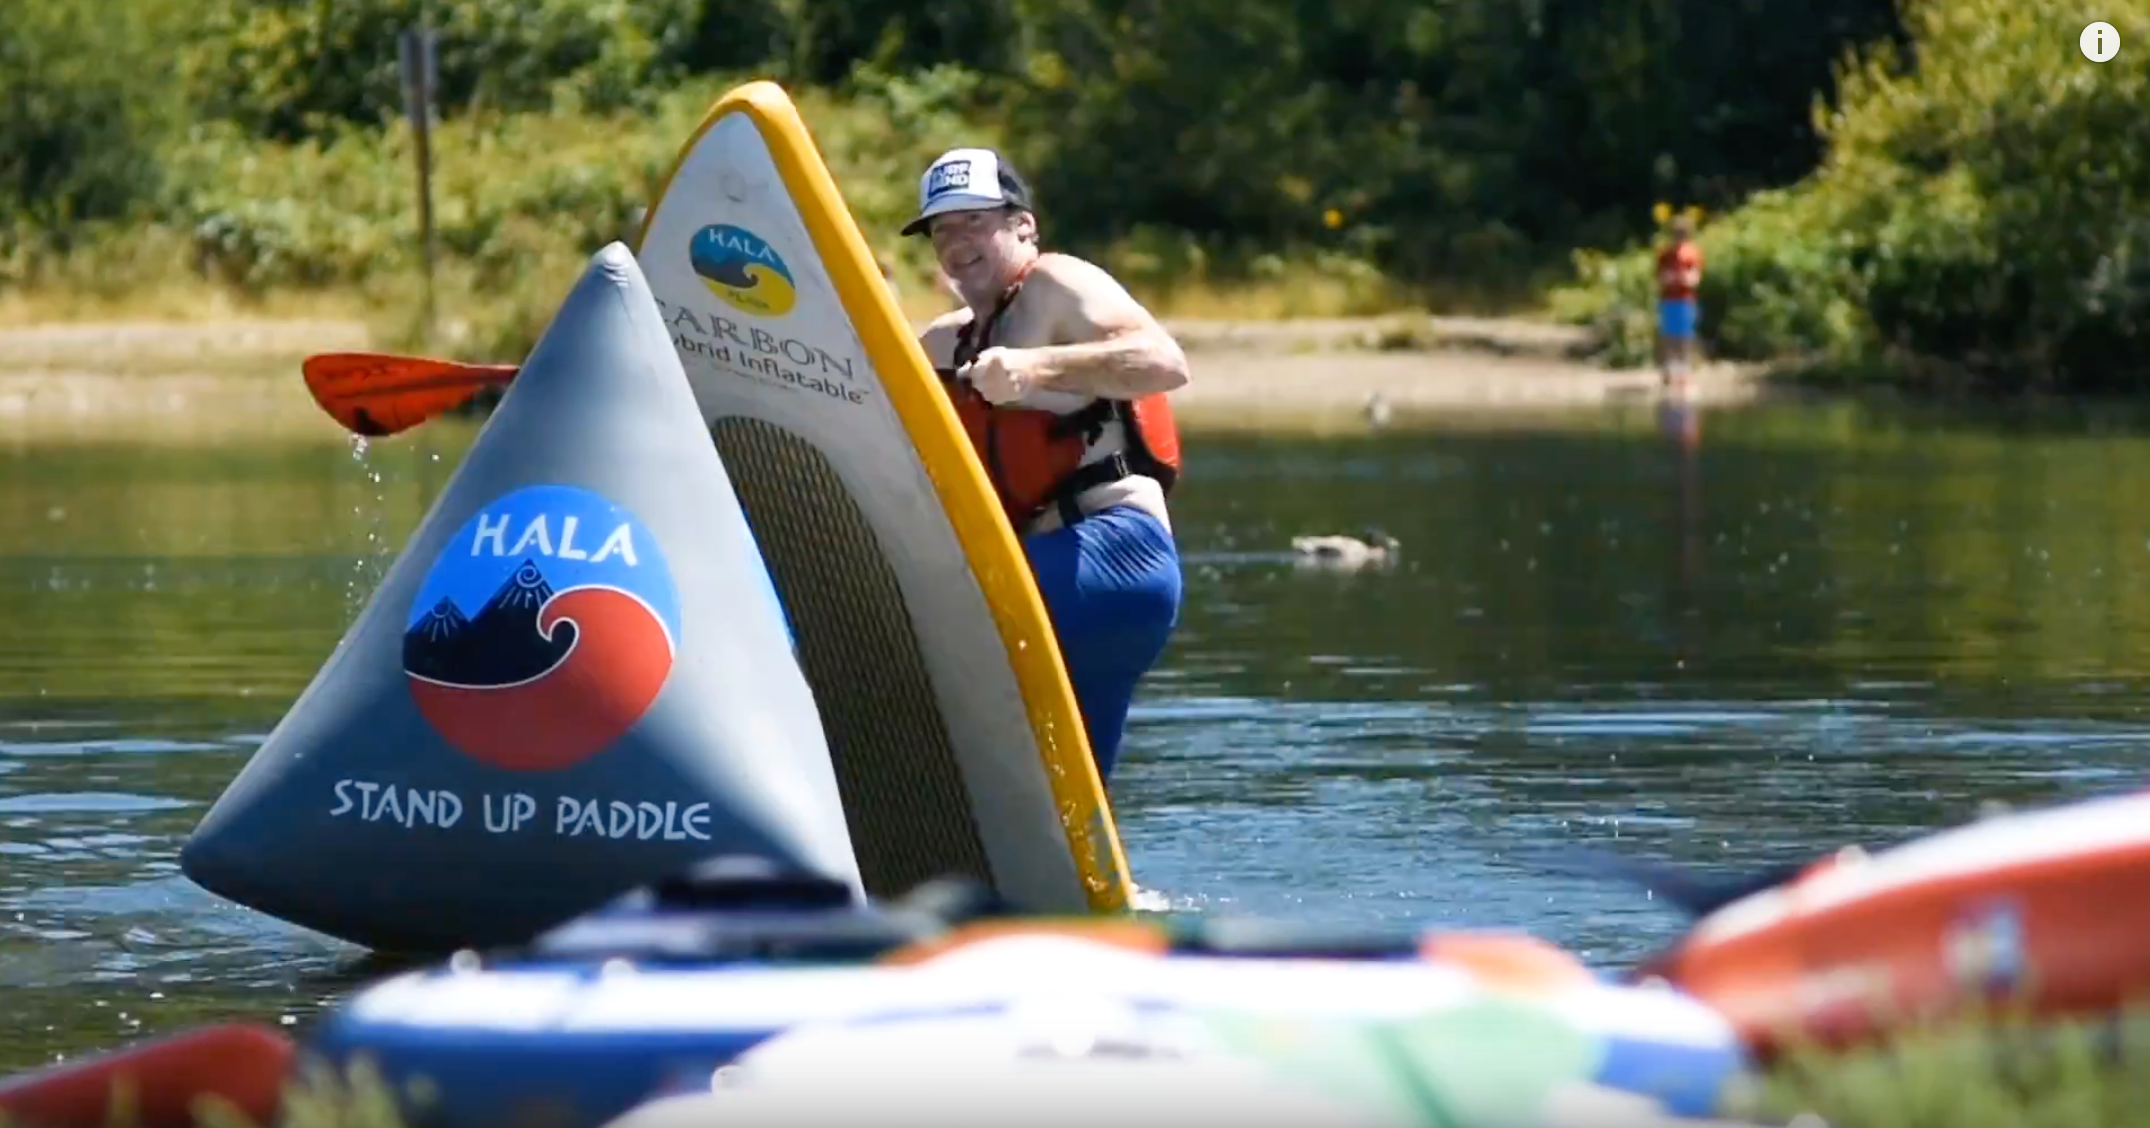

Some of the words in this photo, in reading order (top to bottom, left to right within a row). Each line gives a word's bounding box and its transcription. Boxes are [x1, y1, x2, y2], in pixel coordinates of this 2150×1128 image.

[709, 229, 775, 263] HALA
[740, 353, 865, 405] Inflatable
[470, 512, 638, 567] HALA
[330, 779, 463, 829] STAND
[483, 793, 537, 833] UP
[555, 796, 712, 841] PADDLE
